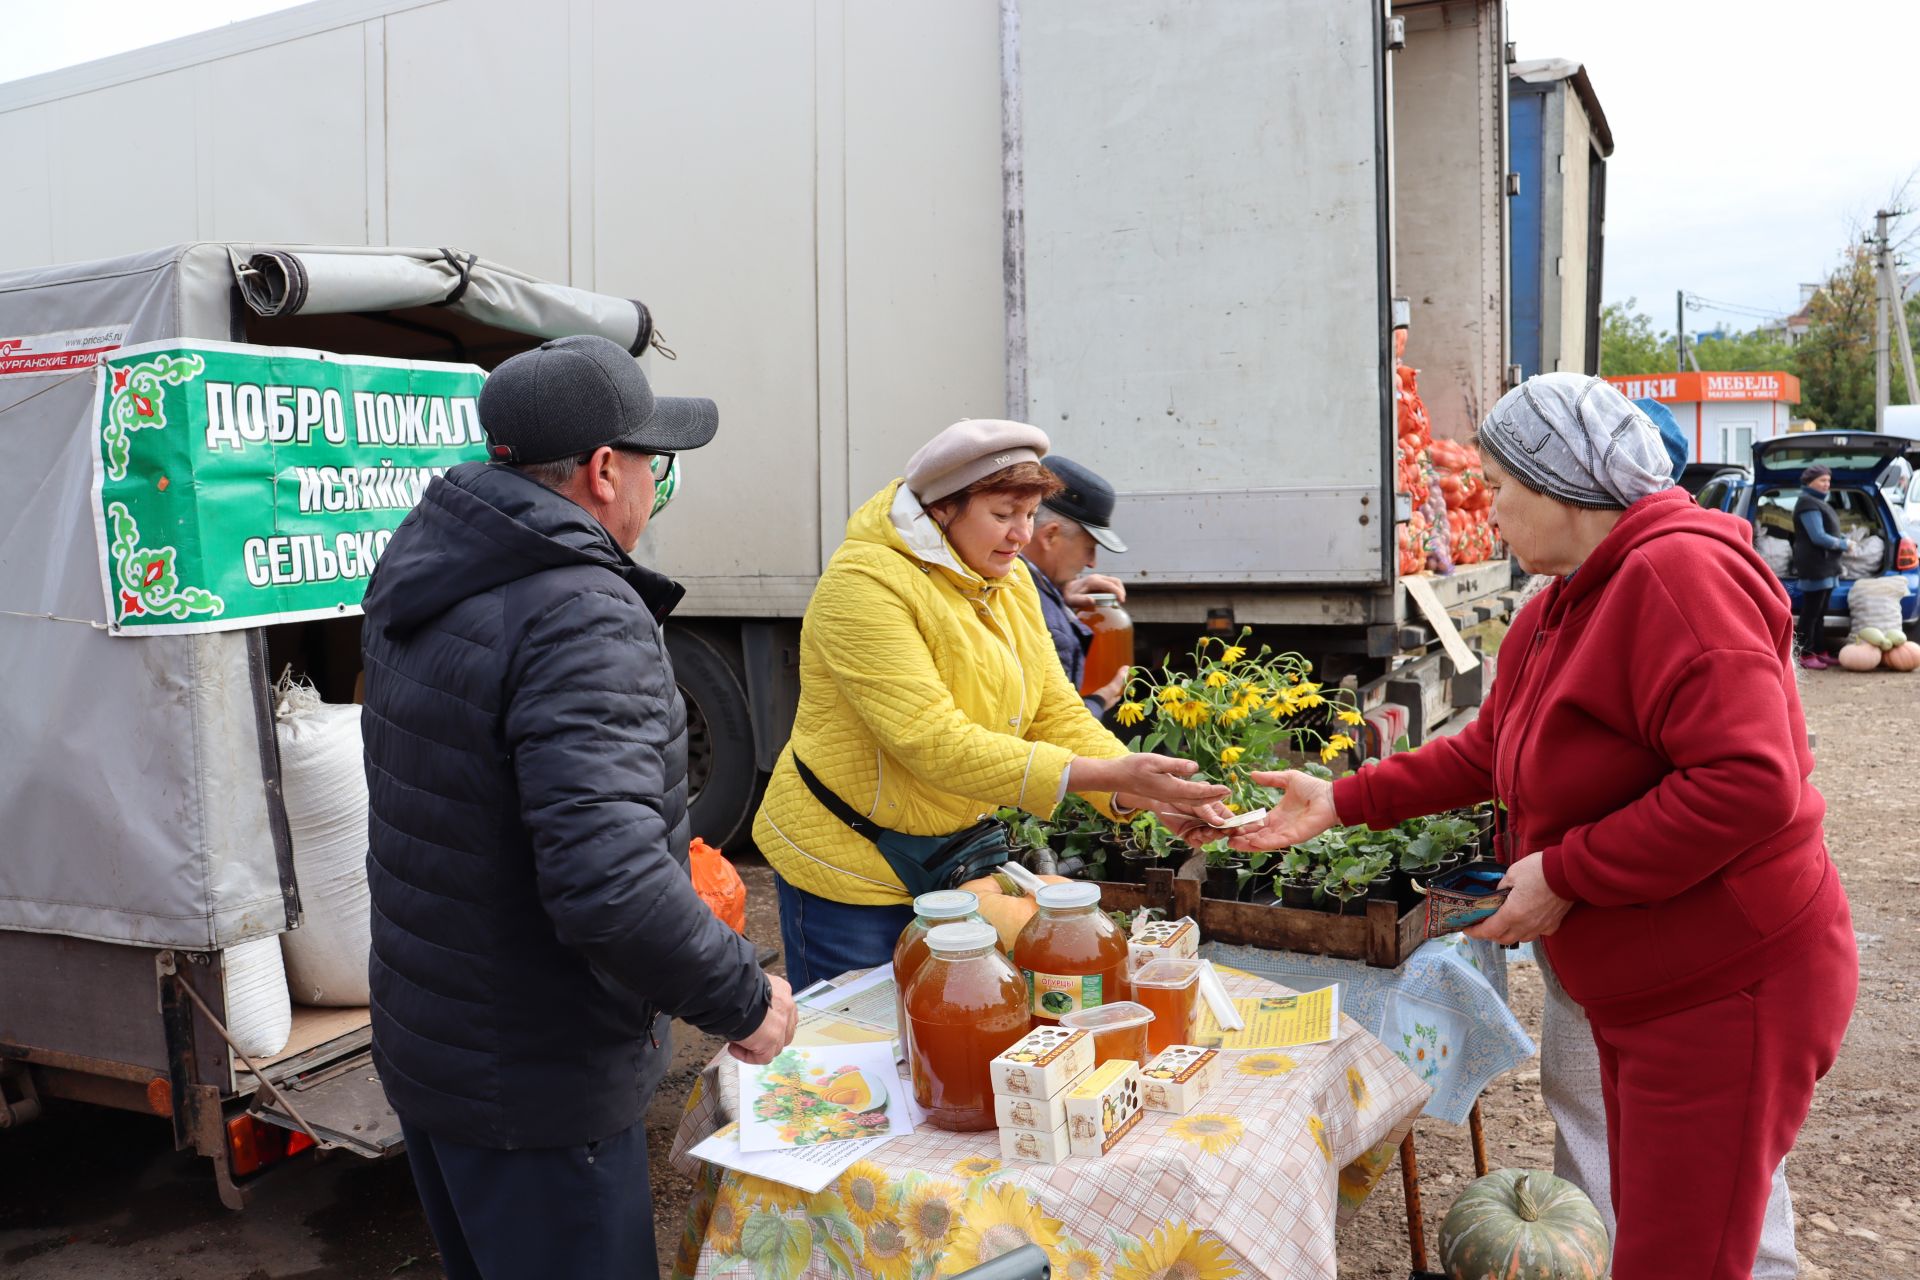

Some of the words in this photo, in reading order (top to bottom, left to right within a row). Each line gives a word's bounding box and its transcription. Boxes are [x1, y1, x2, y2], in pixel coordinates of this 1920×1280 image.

[0, 356, 67, 370] КУРГАНСКИЕ
[70, 353, 98, 366] ПРИЦ
[1707, 375, 1778, 390] МЕБЕЛЬ
[204, 381, 346, 449] ДОБРО
[352, 391, 486, 446] ПОЖАЛ
[296, 459, 452, 512] ИСЛЯЙКИ
[243, 531, 398, 587] СЕЛЬСКО
[1041, 978, 1074, 988] ОГУРЦЫ
